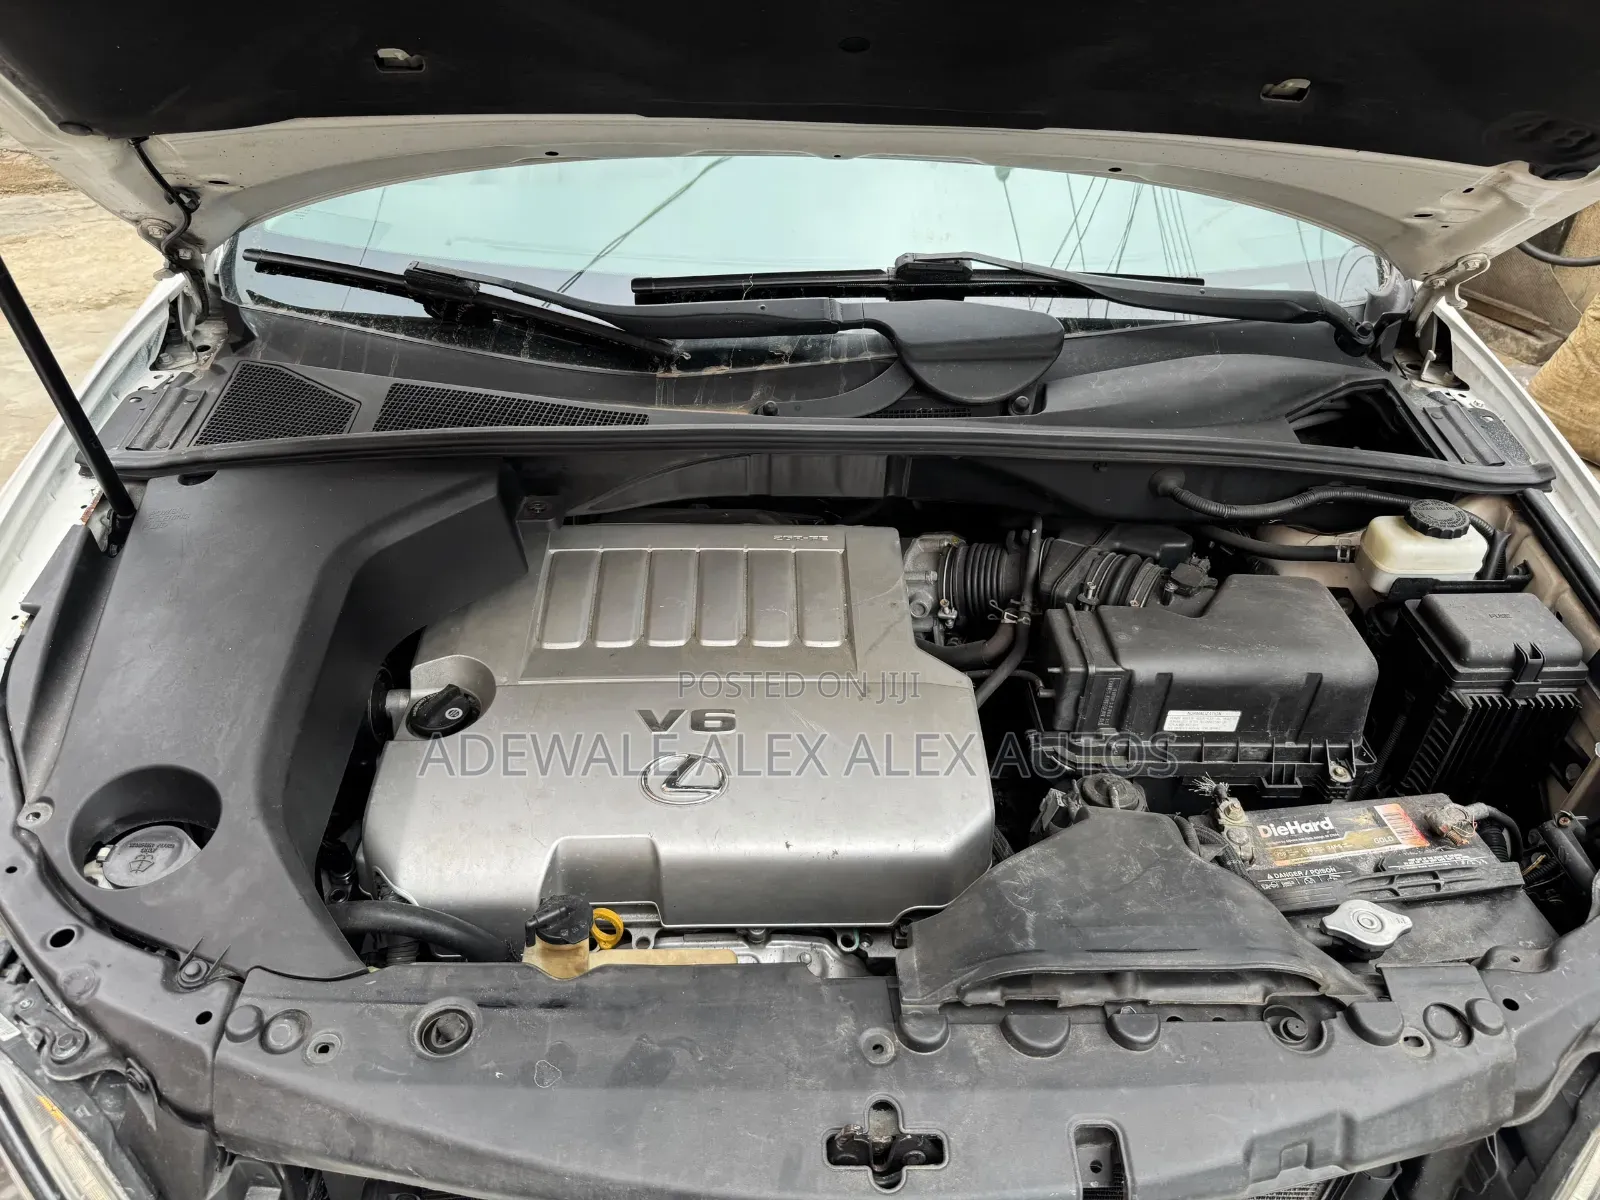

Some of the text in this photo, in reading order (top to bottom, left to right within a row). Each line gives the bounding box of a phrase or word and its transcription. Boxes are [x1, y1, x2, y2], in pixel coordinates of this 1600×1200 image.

[635, 708, 736, 734] V6
[1257, 816, 1334, 838] DieHard
[1373, 835, 1395, 844] GOLD
[1273, 870, 1304, 879] DANGER
[1309, 866, 1337, 875] POISON
